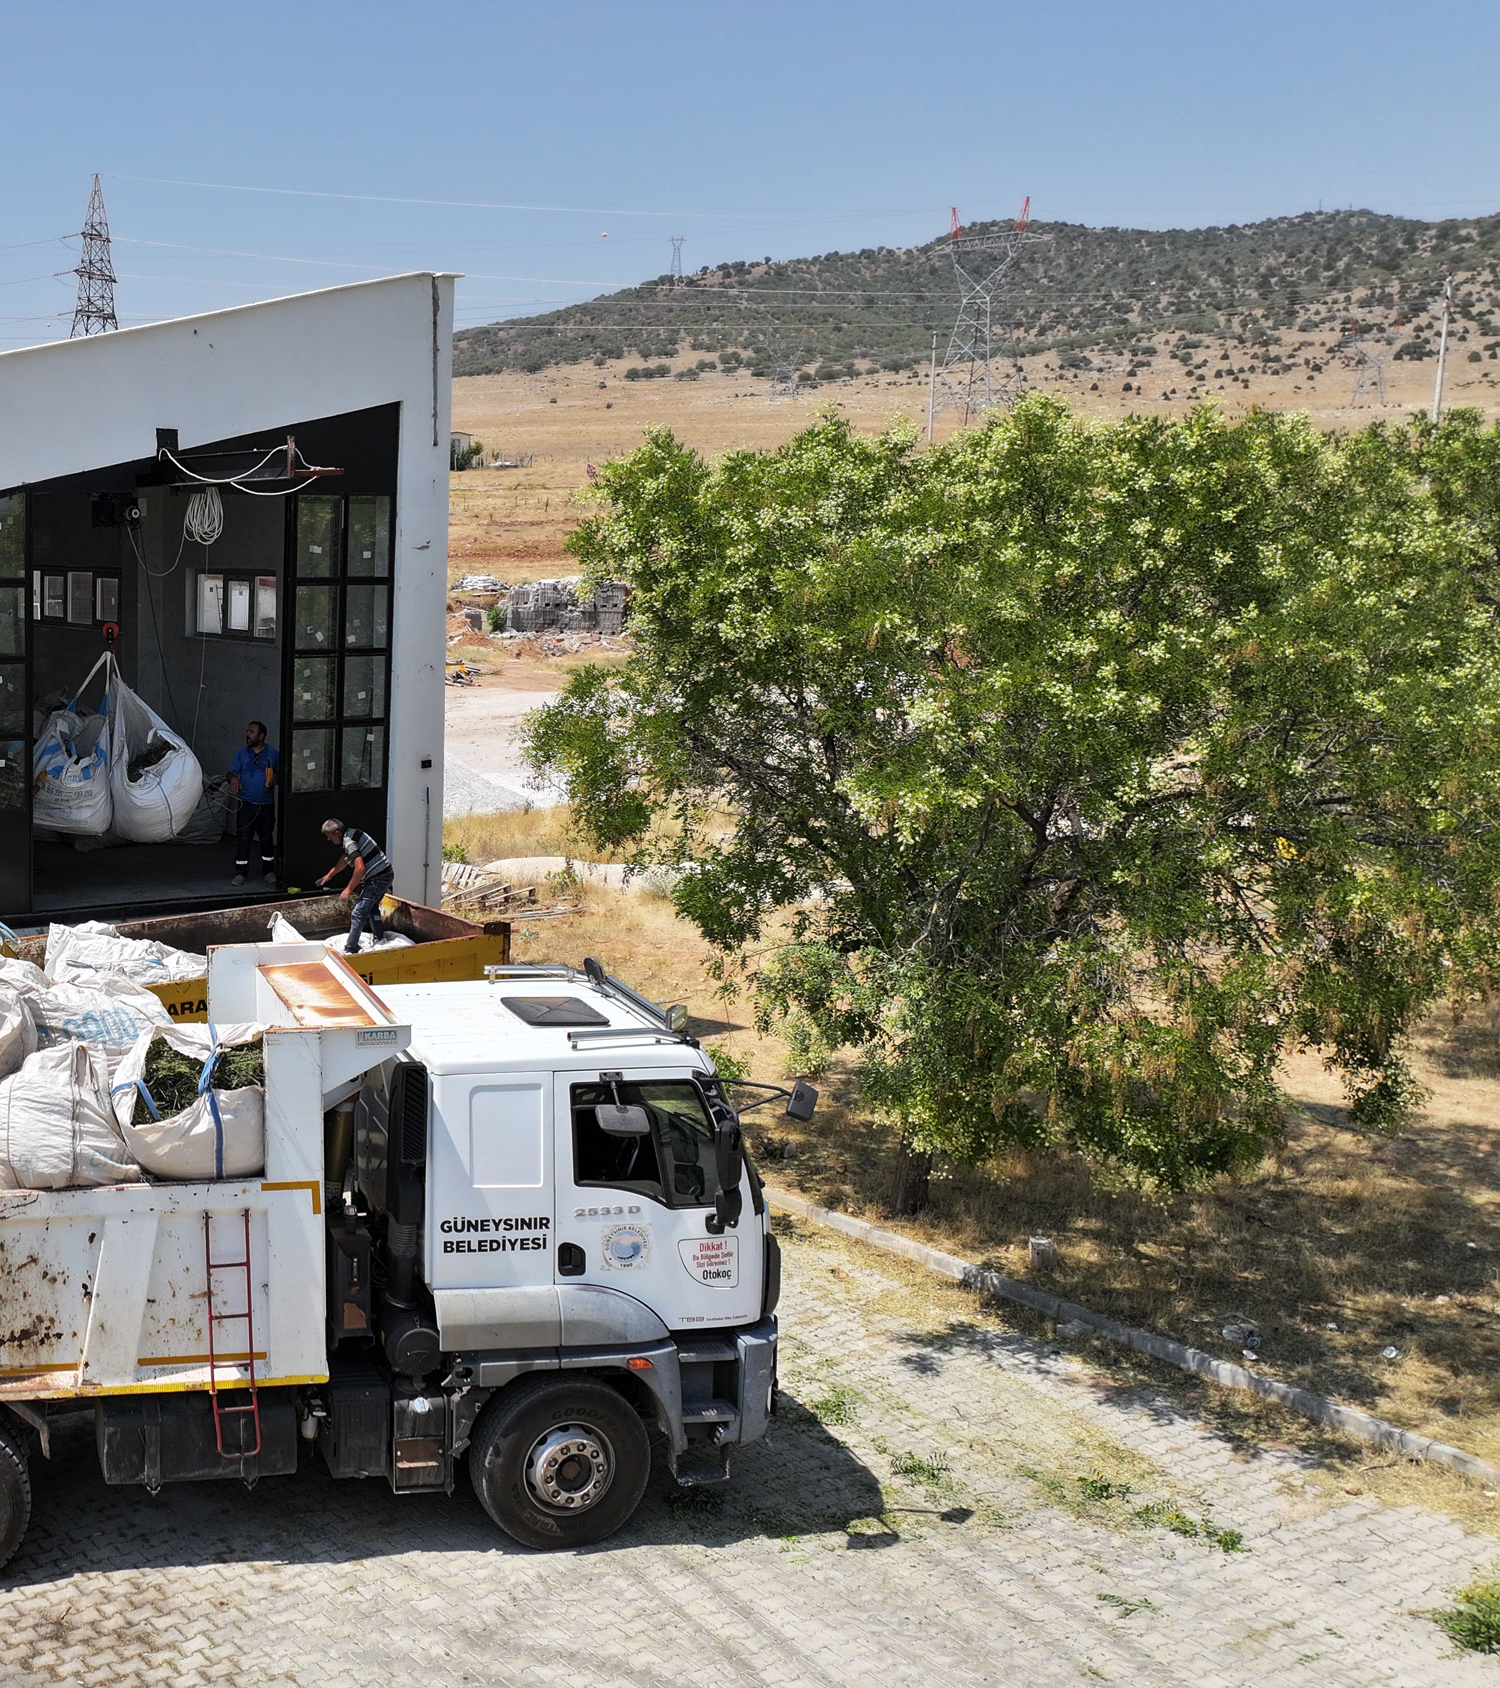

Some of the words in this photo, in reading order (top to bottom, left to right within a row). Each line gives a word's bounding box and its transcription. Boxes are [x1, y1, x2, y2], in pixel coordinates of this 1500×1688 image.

[167, 999, 208, 1016] ARA
[364, 1031, 396, 1040] KARBA
[573, 1205, 624, 1218] 2533
[628, 1205, 641, 1214] D
[440, 1217, 551, 1234] GÜNEYSINIR
[443, 1234, 547, 1253] BELEDİYESİ
[699, 1242, 723, 1252] Dikkat
[702, 1269, 732, 1280] Otokoç
